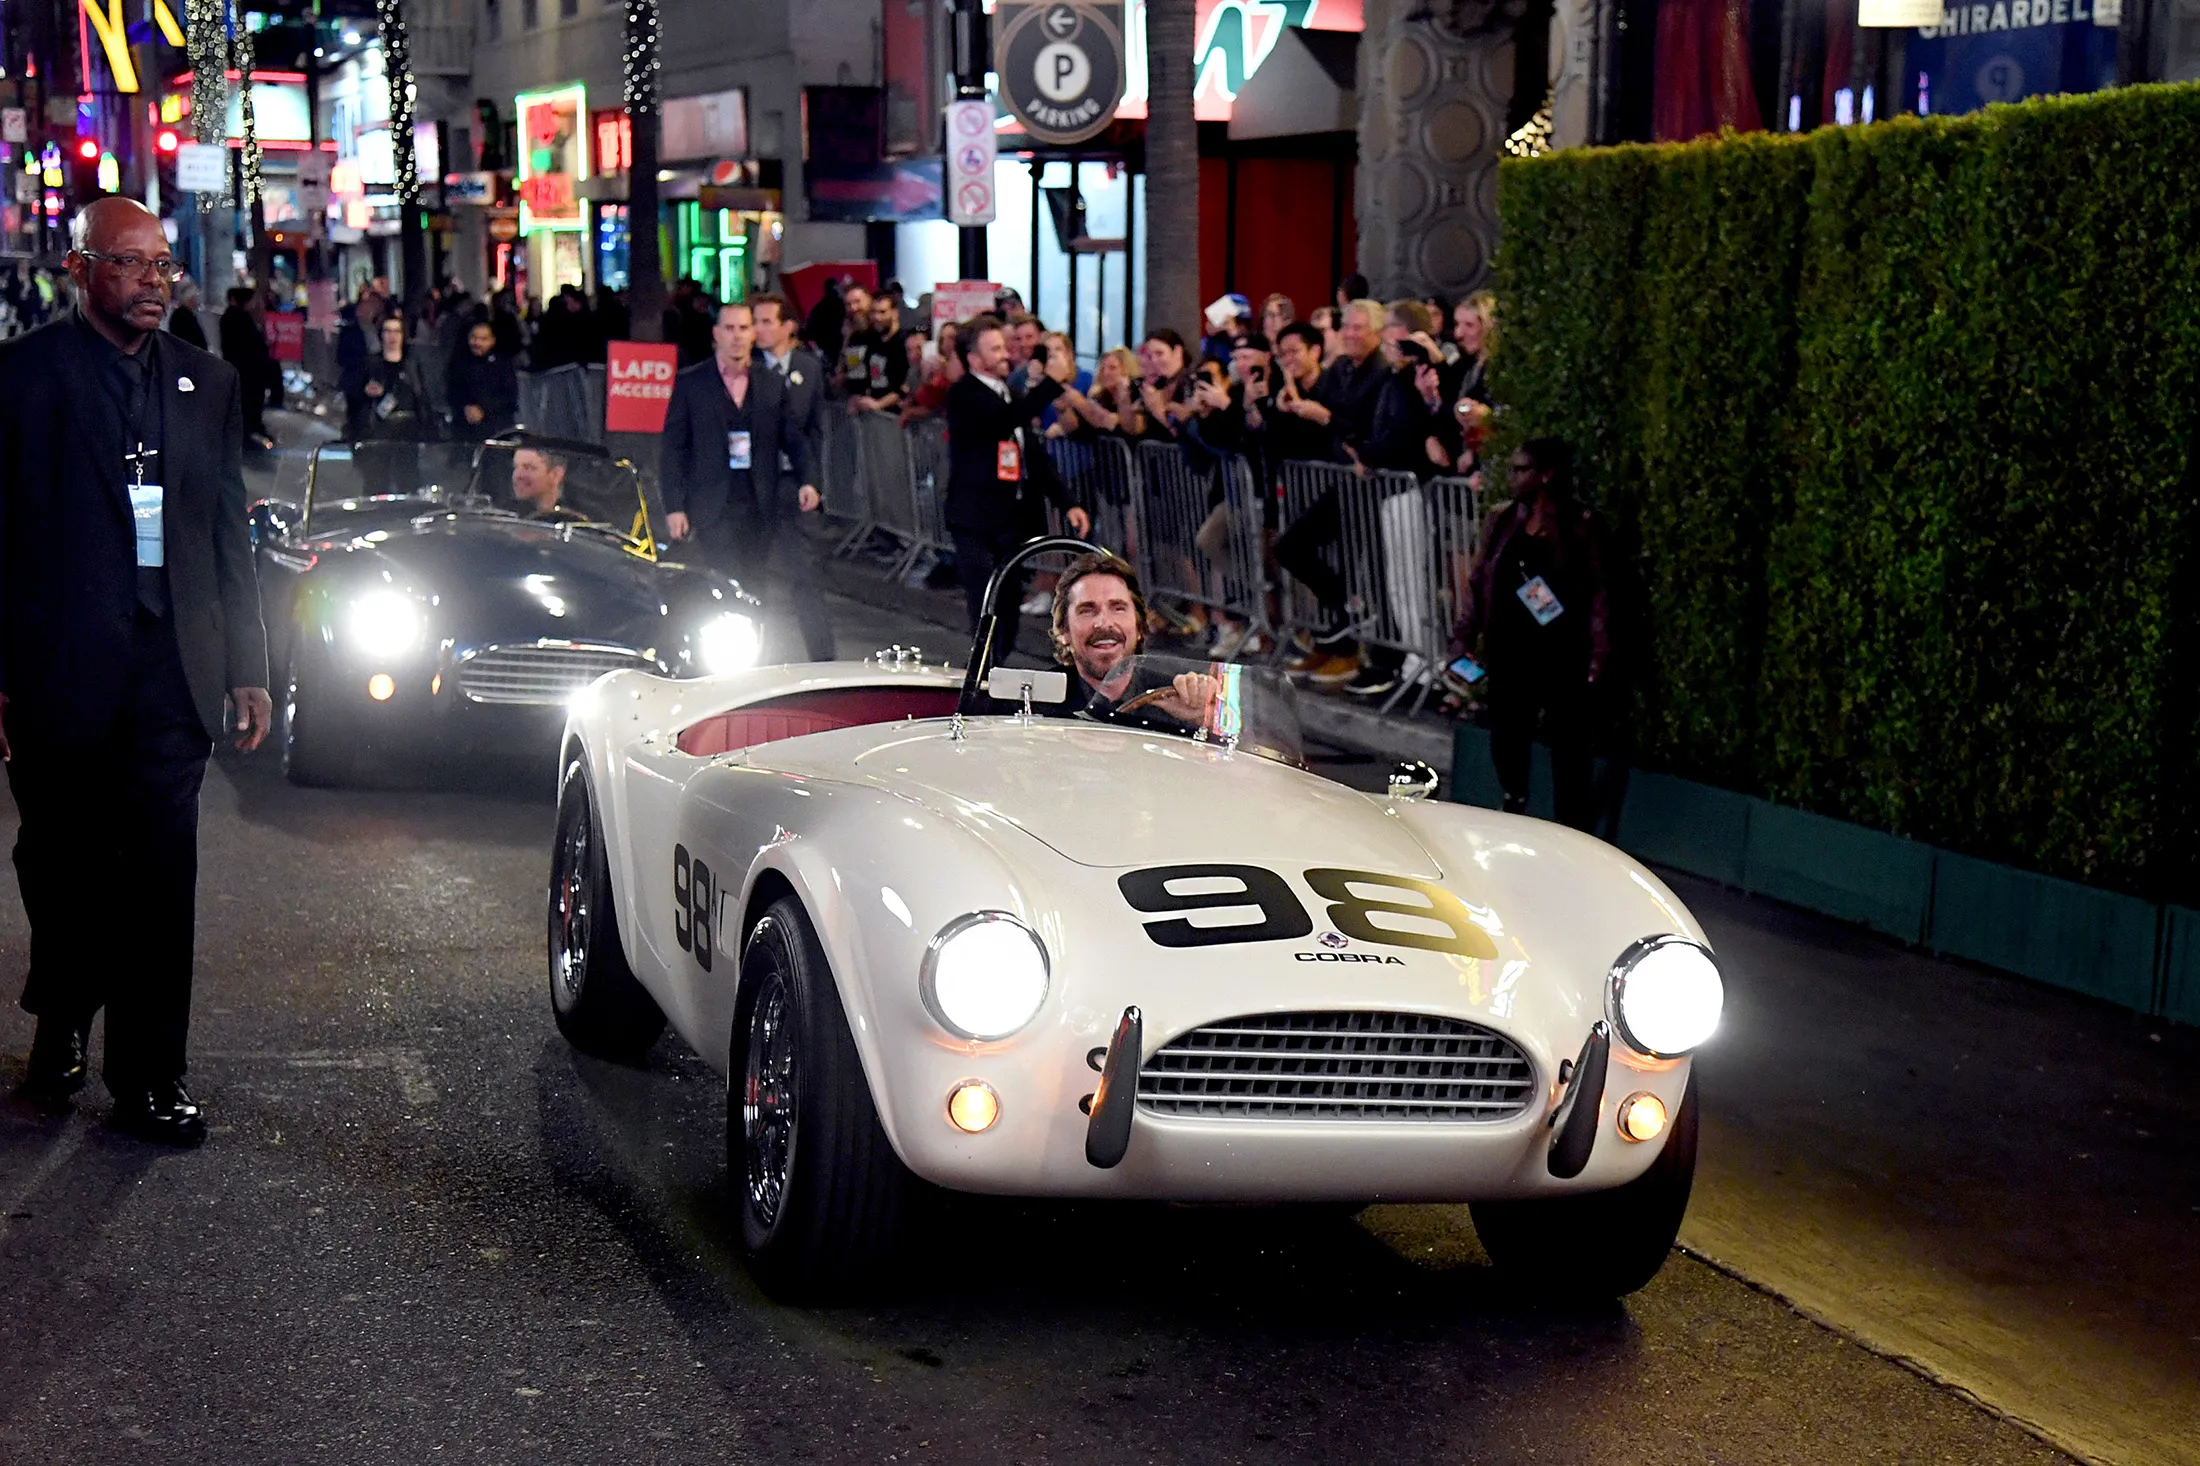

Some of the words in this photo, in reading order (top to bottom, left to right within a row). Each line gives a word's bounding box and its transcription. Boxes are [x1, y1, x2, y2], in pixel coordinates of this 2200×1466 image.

[1055, 54, 1074, 91] P
[1027, 98, 1101, 127] PARKING
[611, 359, 672, 381] LAFD
[611, 381, 672, 399] ACCESS
[674, 843, 712, 972] 98
[1117, 863, 1499, 961] 98
[1293, 951, 1407, 967] COBRA
